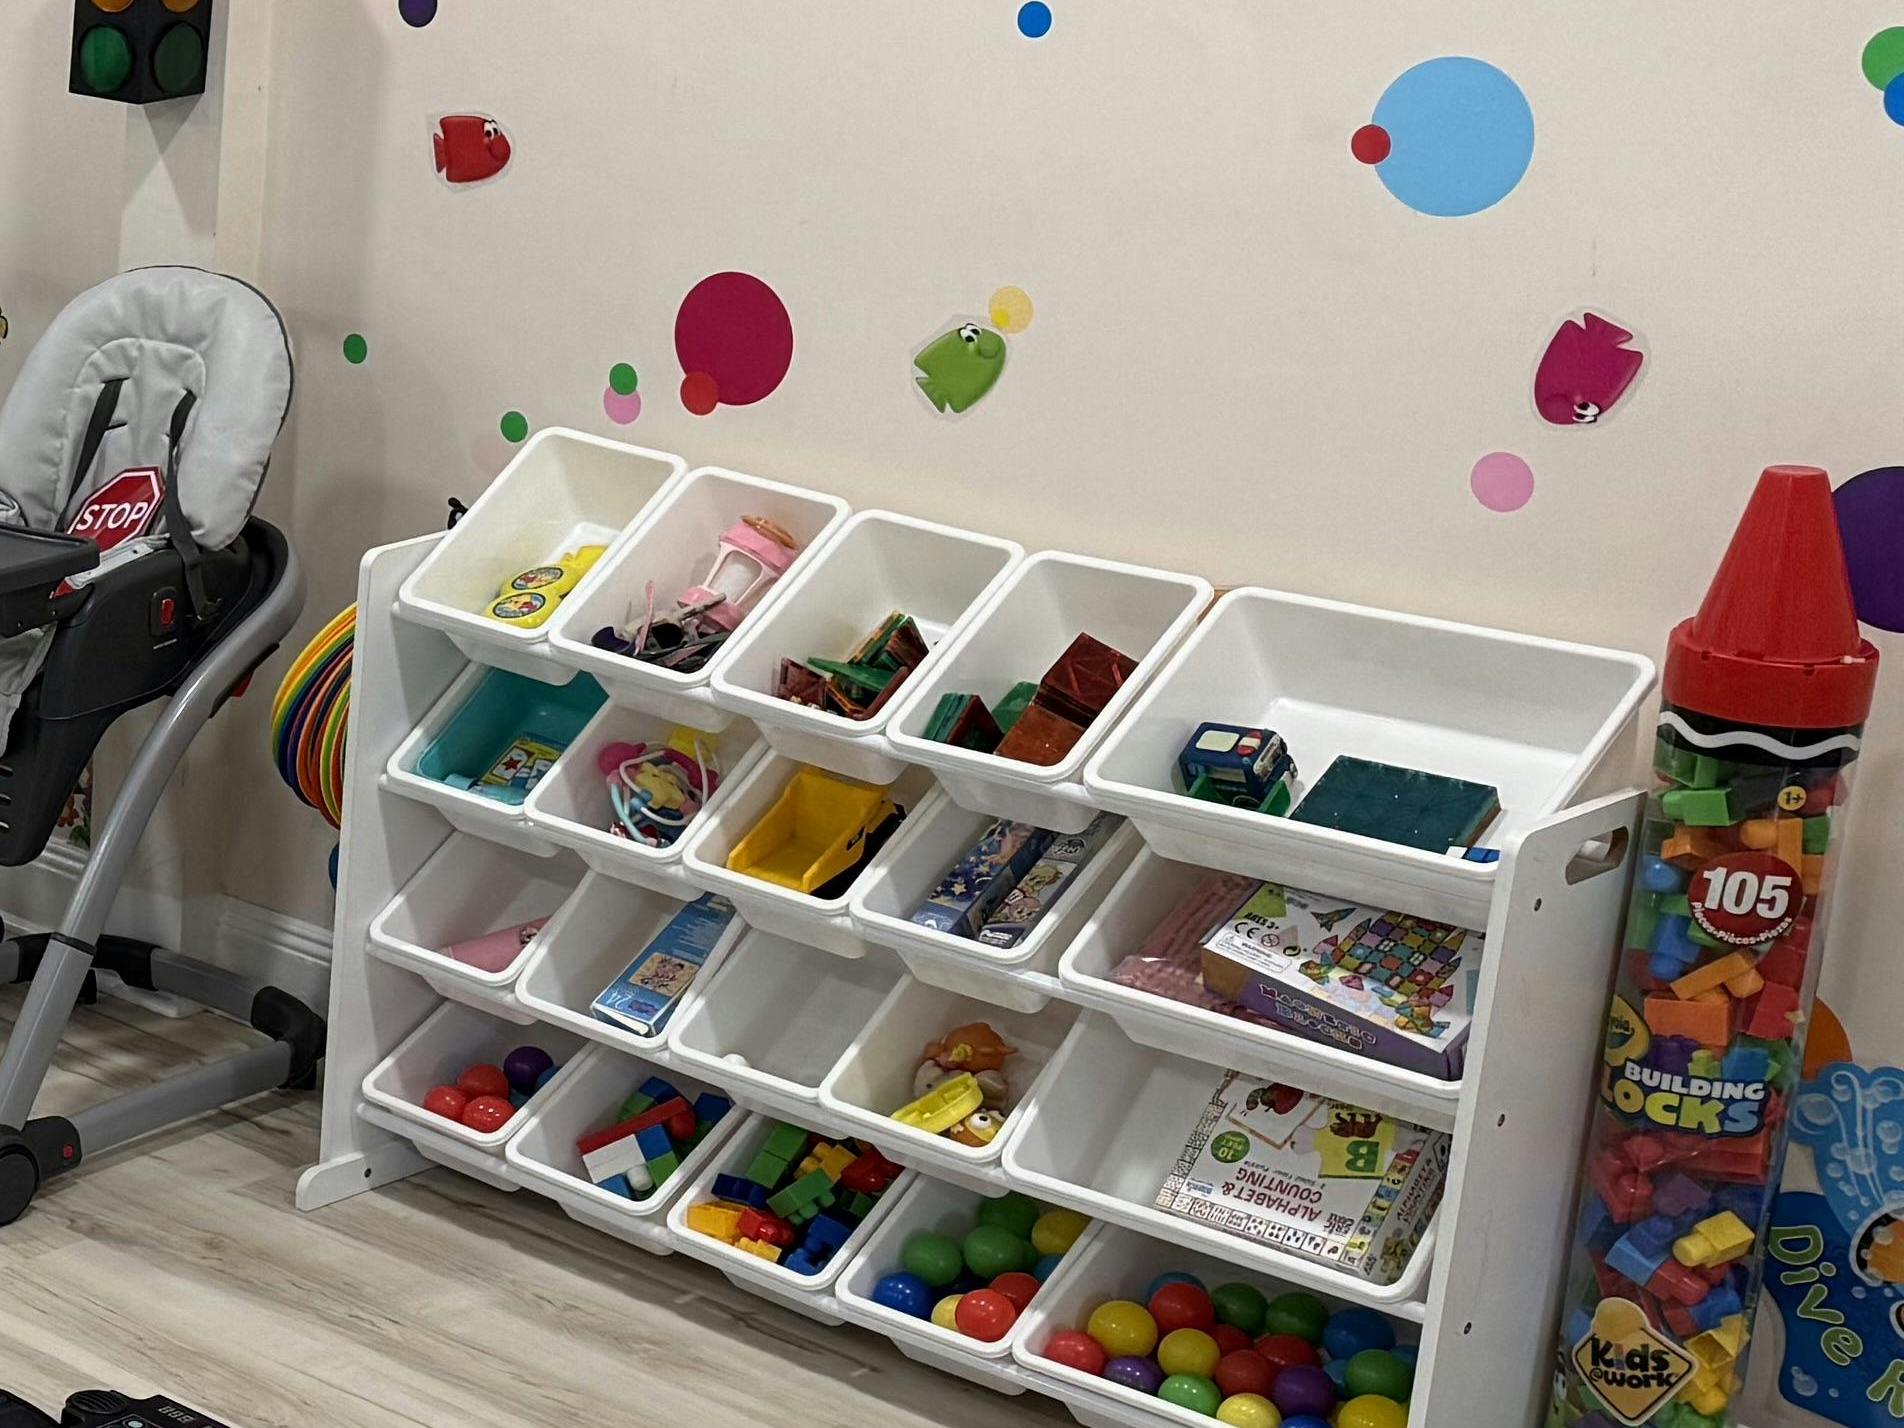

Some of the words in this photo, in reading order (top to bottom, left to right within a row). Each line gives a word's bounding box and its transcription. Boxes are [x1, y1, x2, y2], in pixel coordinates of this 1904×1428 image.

[76, 502, 148, 530] STOP
[1703, 867, 1792, 919] 105
[1624, 1061, 1765, 1100] BUILDING
[1601, 1066, 1760, 1134] LOCKS
[1345, 1140, 1378, 1173] B
[1234, 1186, 1322, 1222] ALPHABET
[1236, 1167, 1323, 1204] COUNTING
[1768, 1224, 1866, 1368] Dive
[1591, 1337, 1669, 1372] Kids
